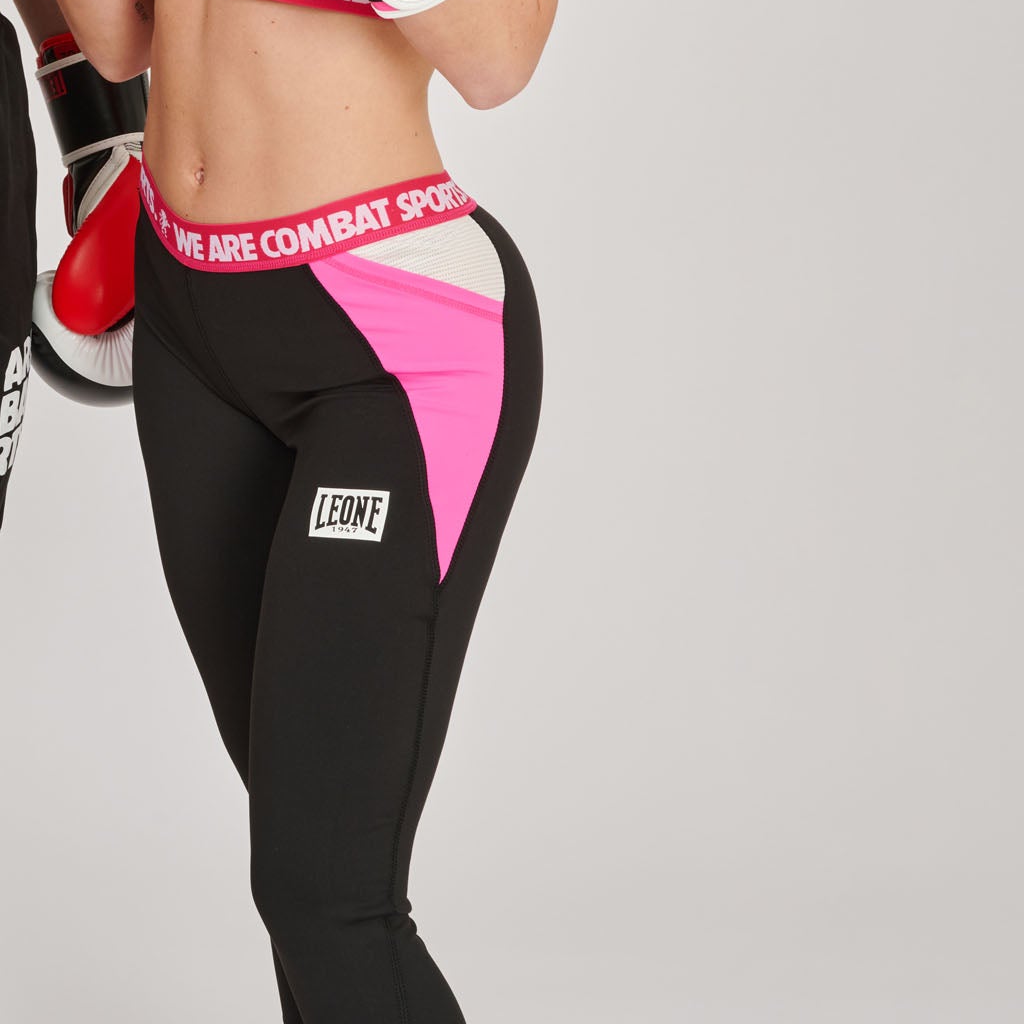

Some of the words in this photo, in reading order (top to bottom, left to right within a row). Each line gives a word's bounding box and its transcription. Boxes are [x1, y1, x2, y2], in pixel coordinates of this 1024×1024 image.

[172, 221, 205, 262] WE
[208, 232, 258, 263] ARE
[260, 197, 392, 258] COMBAT
[3, 335, 32, 392] AR
[314, 493, 383, 534] LEONE
